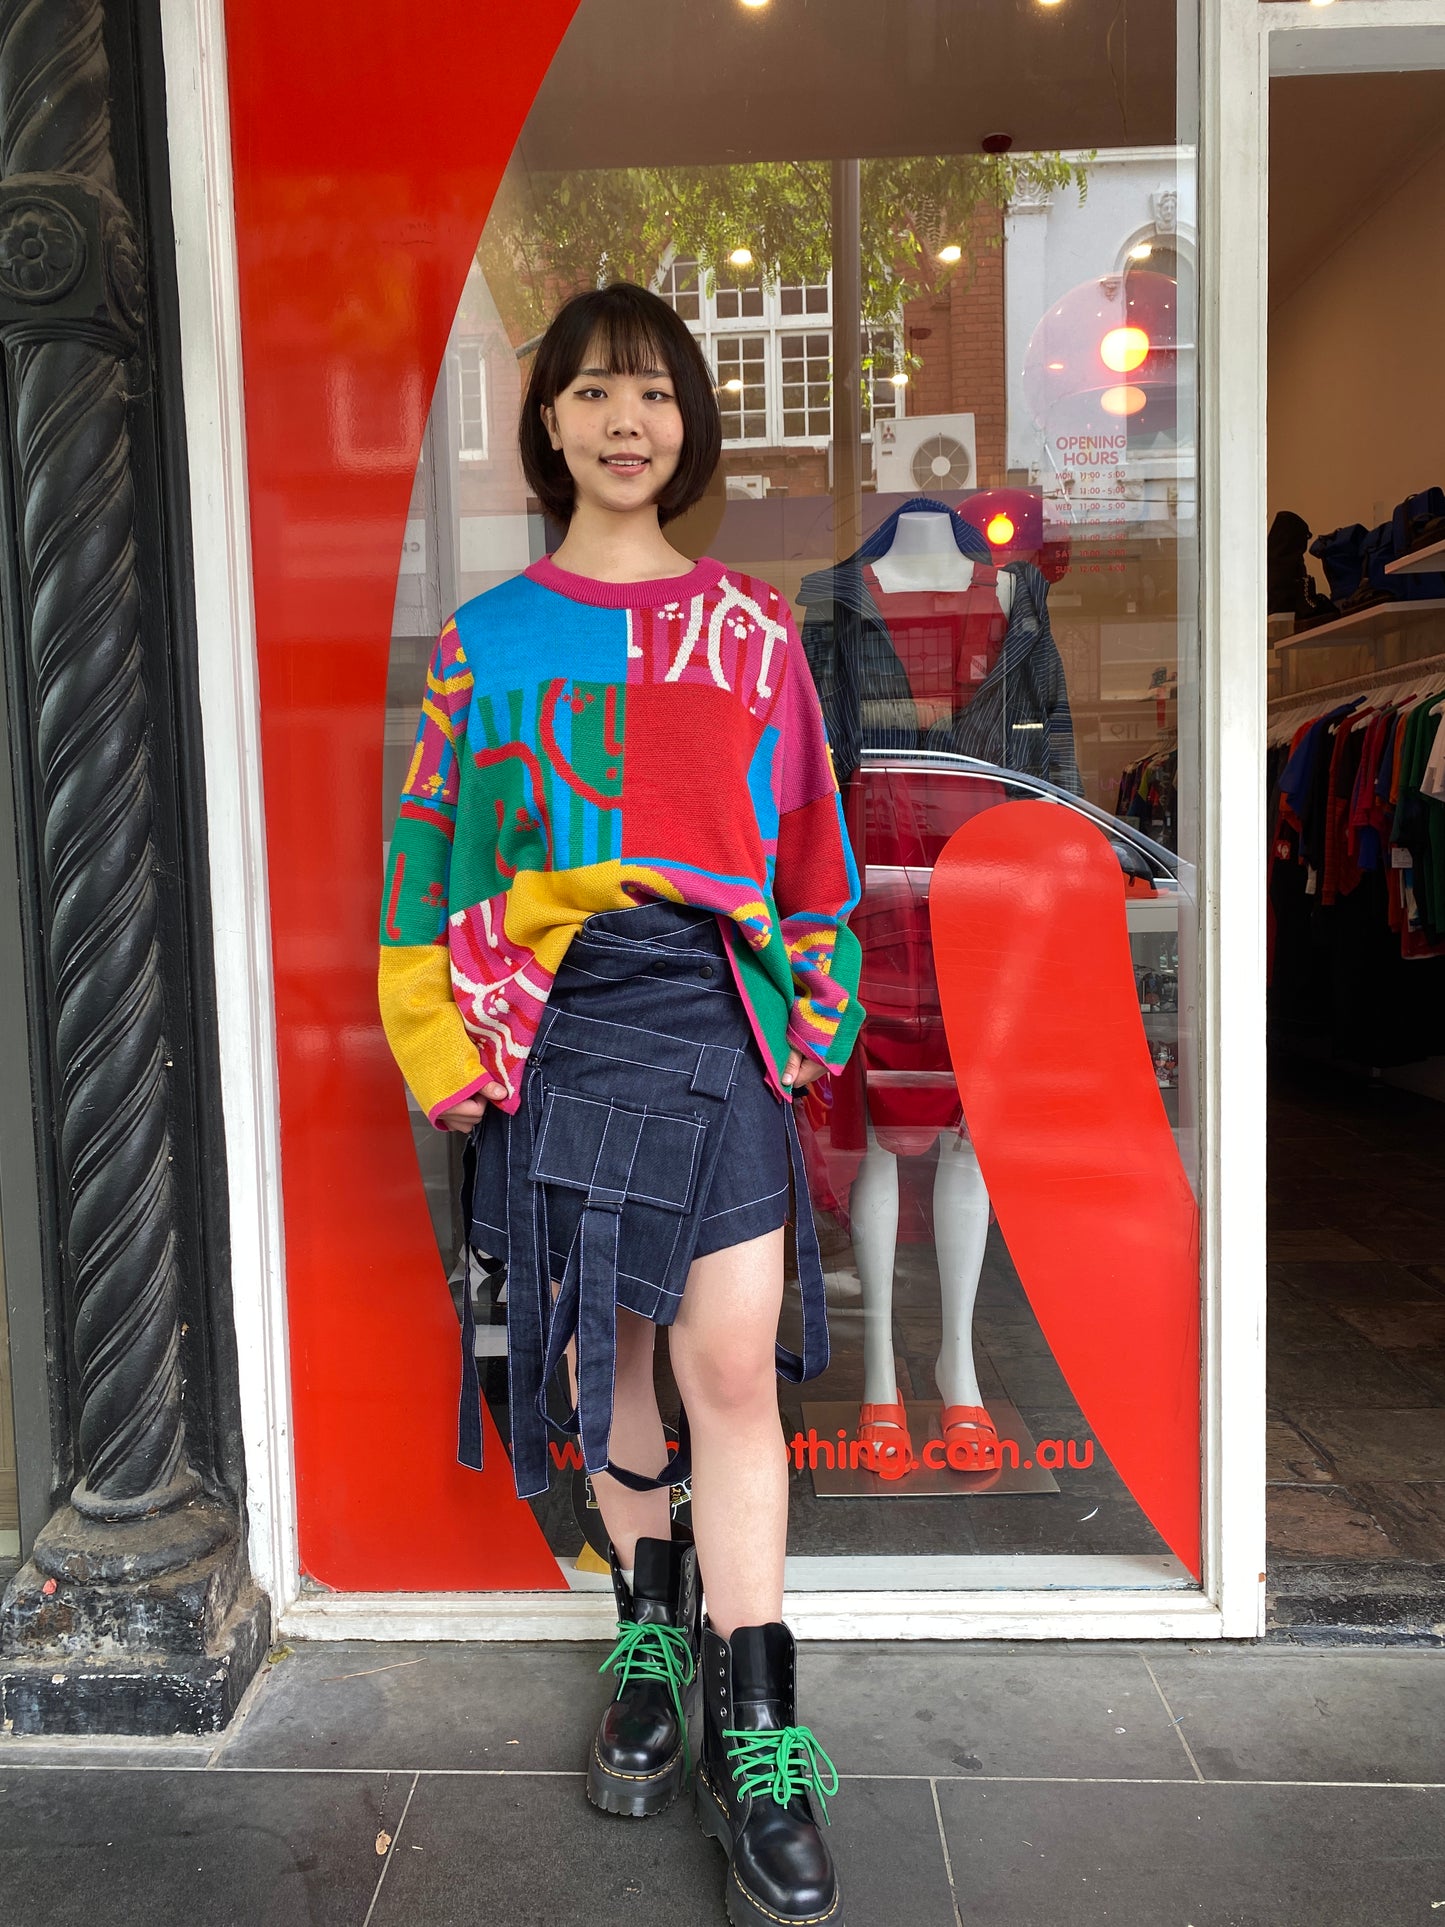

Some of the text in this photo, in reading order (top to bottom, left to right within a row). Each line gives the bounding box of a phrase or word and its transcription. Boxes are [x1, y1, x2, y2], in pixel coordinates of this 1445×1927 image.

[1056, 435, 1126, 450] OPENING
[1063, 451, 1119, 466] HOURS
[1055, 472, 1073, 480] MON
[1080, 472, 1100, 480] 11:00
[1108, 471, 1126, 479] 5:00
[1108, 486, 1126, 495] 5:00
[1080, 503, 1100, 511] 11:00
[1108, 502, 1126, 510] 5:00
[1055, 566, 1073, 574] SUN
